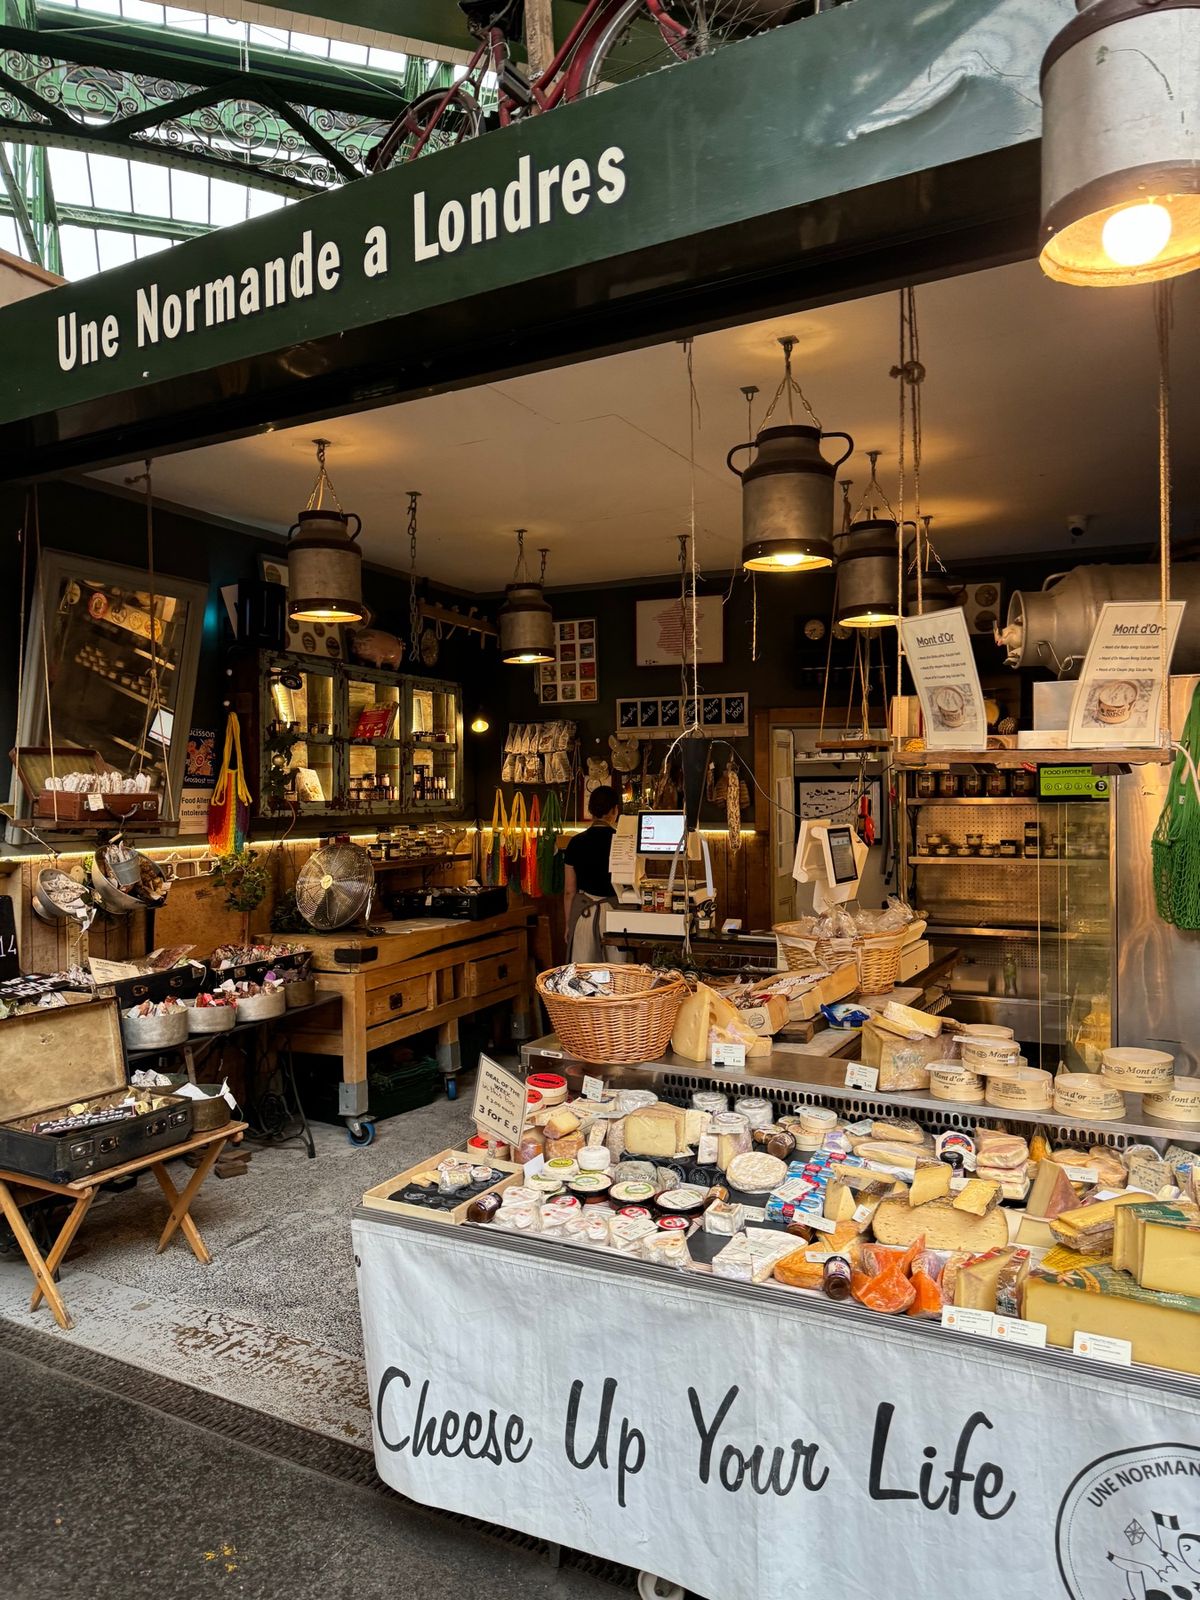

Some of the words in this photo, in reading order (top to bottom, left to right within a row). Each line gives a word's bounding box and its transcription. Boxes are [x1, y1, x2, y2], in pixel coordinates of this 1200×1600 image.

[57, 312, 119, 371] Une
[136, 230, 341, 348] Normande
[364, 225, 388, 278] a
[413, 146, 627, 263] Londres
[1113, 623, 1140, 634] Mont
[1141, 623, 1161, 634] d'Or
[916, 635, 938, 646] Mont
[938, 632, 954, 642] d'Or
[1098, 781, 1105, 790] 5
[988, 1050, 1009, 1058] Mont
[1126, 1066, 1150, 1075] Mont
[1150, 1066, 1166, 1075] d'or
[485, 1071, 500, 1085] DEAL
[949, 1074, 965, 1083] d'or
[1070, 1091, 1087, 1100] d'or
[478, 1104, 486, 1114] 3
[487, 1108, 502, 1123] for
[503, 1119, 511, 1129] £
[512, 1125, 518, 1134] 6
[376, 1366, 533, 1466] Cheese
[565, 1377, 646, 1508] Up
[687, 1384, 830, 1496] Your
[868, 1401, 1017, 1520] Life
[1086, 1476, 1120, 1508] UNE
[1116, 1459, 1200, 1492] NORMAN
